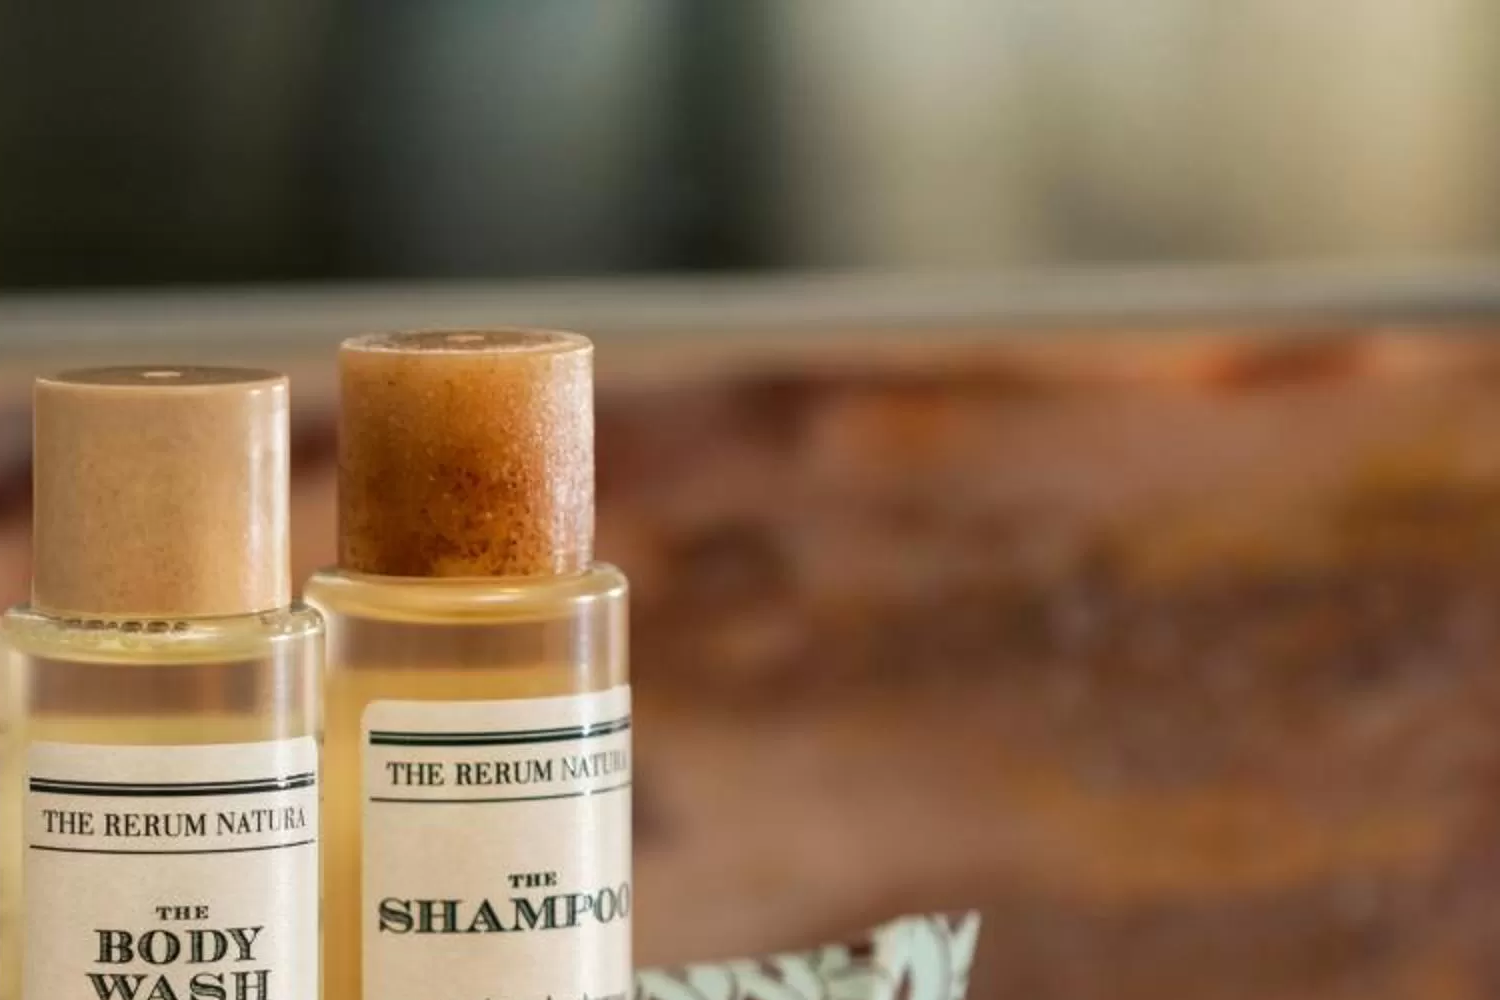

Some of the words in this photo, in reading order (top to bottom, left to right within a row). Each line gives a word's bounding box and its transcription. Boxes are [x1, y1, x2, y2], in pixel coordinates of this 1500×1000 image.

[386, 761, 444, 786] THE
[455, 760, 552, 786] RERUM
[43, 810, 94, 836] THE
[104, 813, 206, 837] RERUM
[216, 807, 307, 835] NATURA
[508, 872, 557, 888] THE
[156, 906, 209, 920] THE
[378, 882, 629, 933] SHAMPOO
[94, 926, 264, 965] BODY
